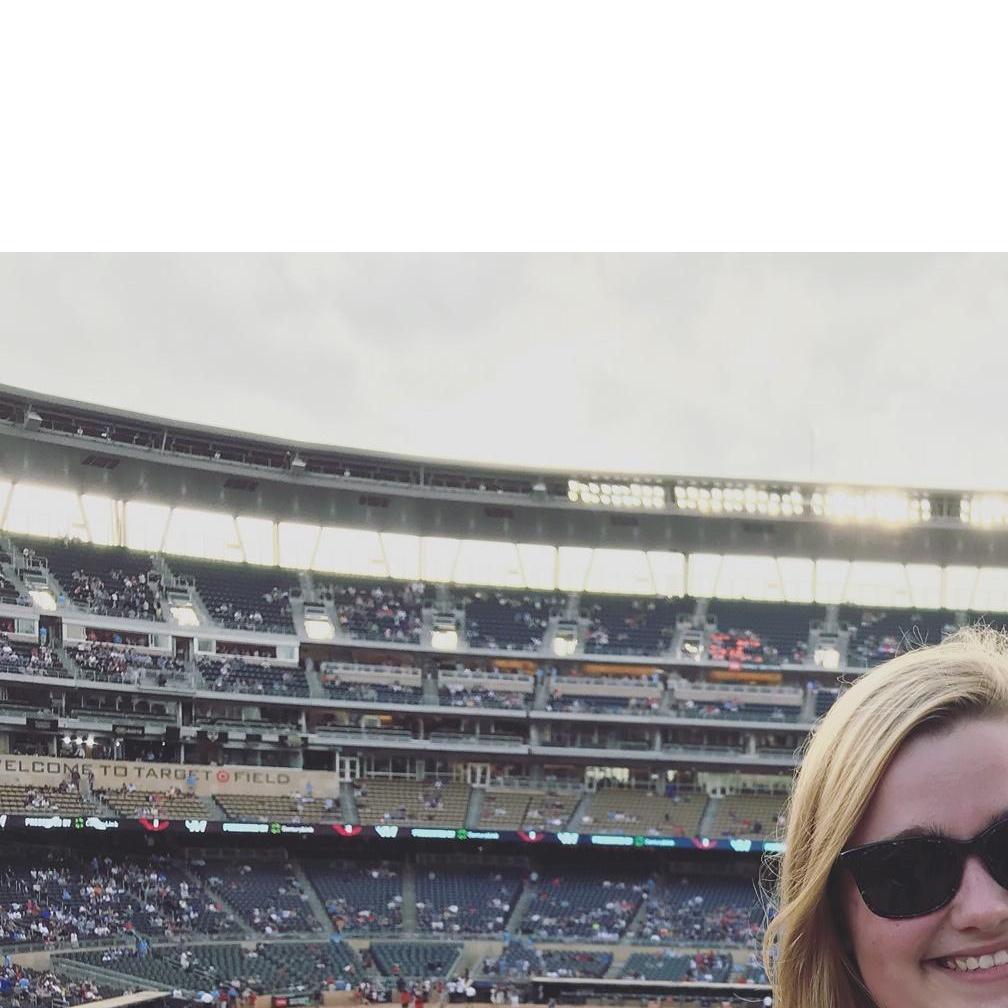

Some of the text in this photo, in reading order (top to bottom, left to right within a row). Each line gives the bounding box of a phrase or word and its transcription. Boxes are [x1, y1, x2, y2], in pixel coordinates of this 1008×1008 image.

[0, 759, 290, 784] ELCOME TO TARGET FIELD
